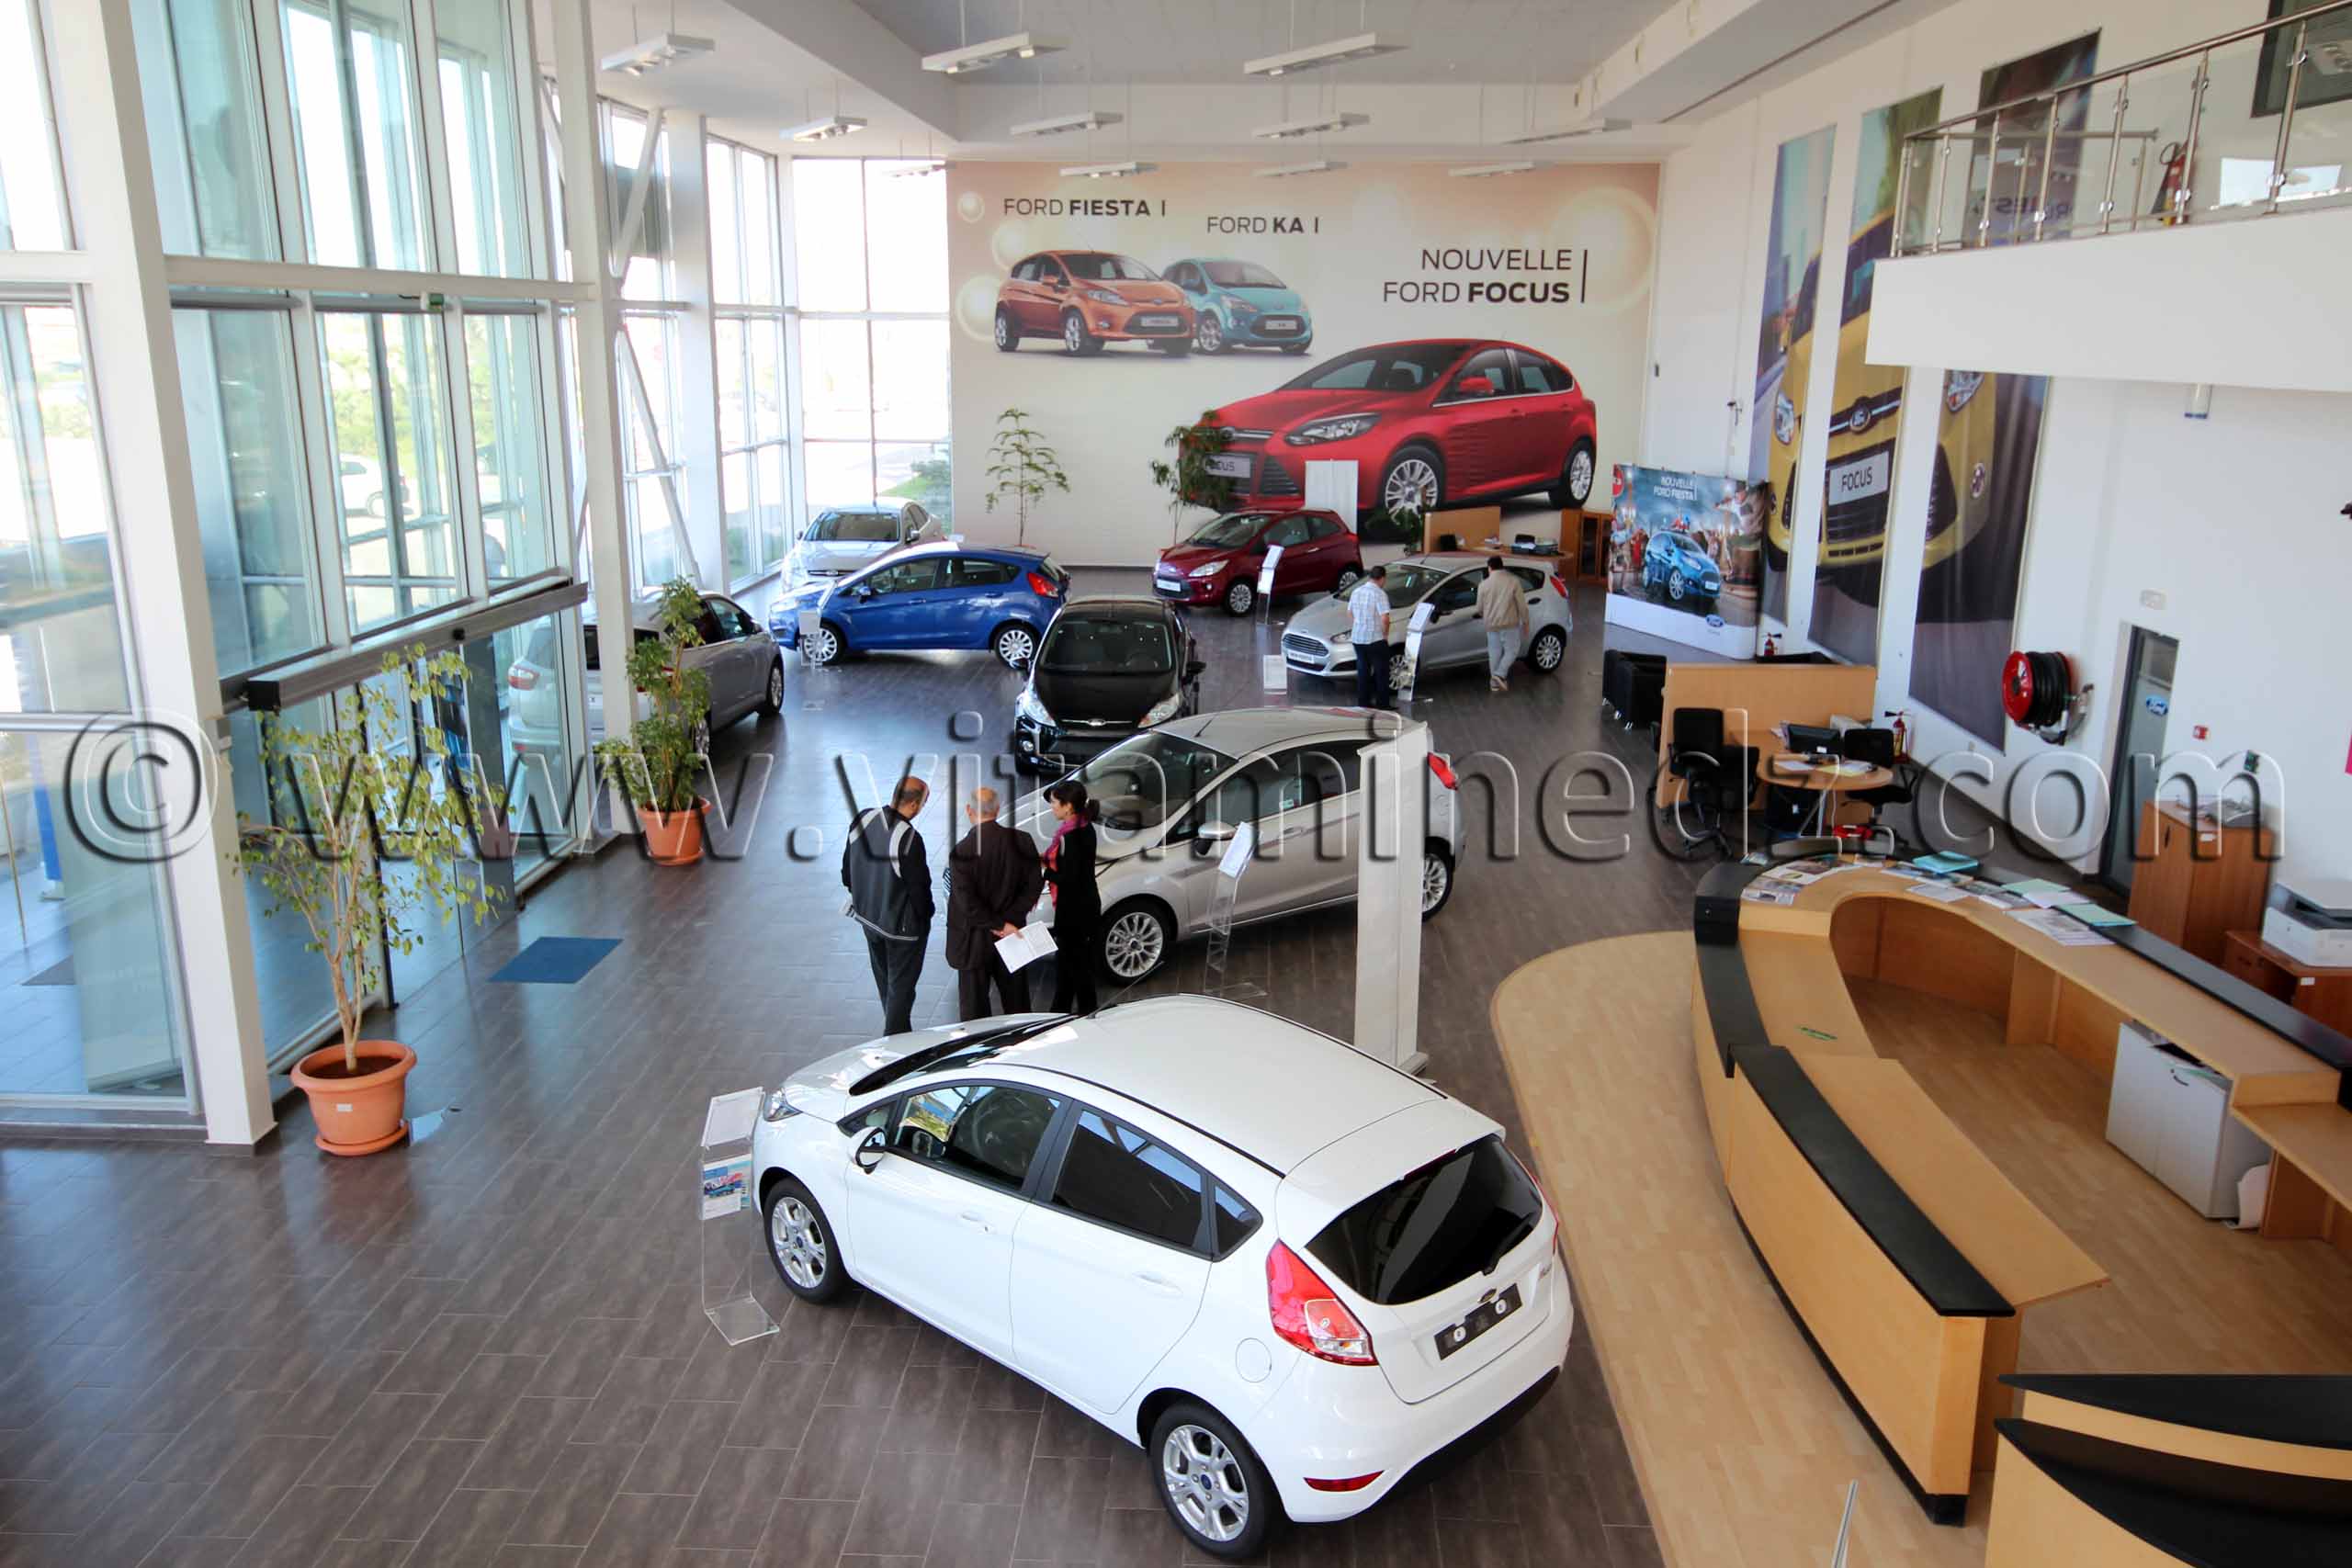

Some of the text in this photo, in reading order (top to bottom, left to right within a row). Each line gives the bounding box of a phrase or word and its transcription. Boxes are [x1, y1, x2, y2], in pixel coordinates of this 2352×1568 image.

[1003, 197, 1151, 217] FORD FIESTA
[1207, 216, 1305, 234] FORD KA
[1421, 249, 1572, 271] NOUVELLE
[1383, 281, 1570, 304] FORD FOCUS
[1840, 466, 1872, 493] FOCUS
